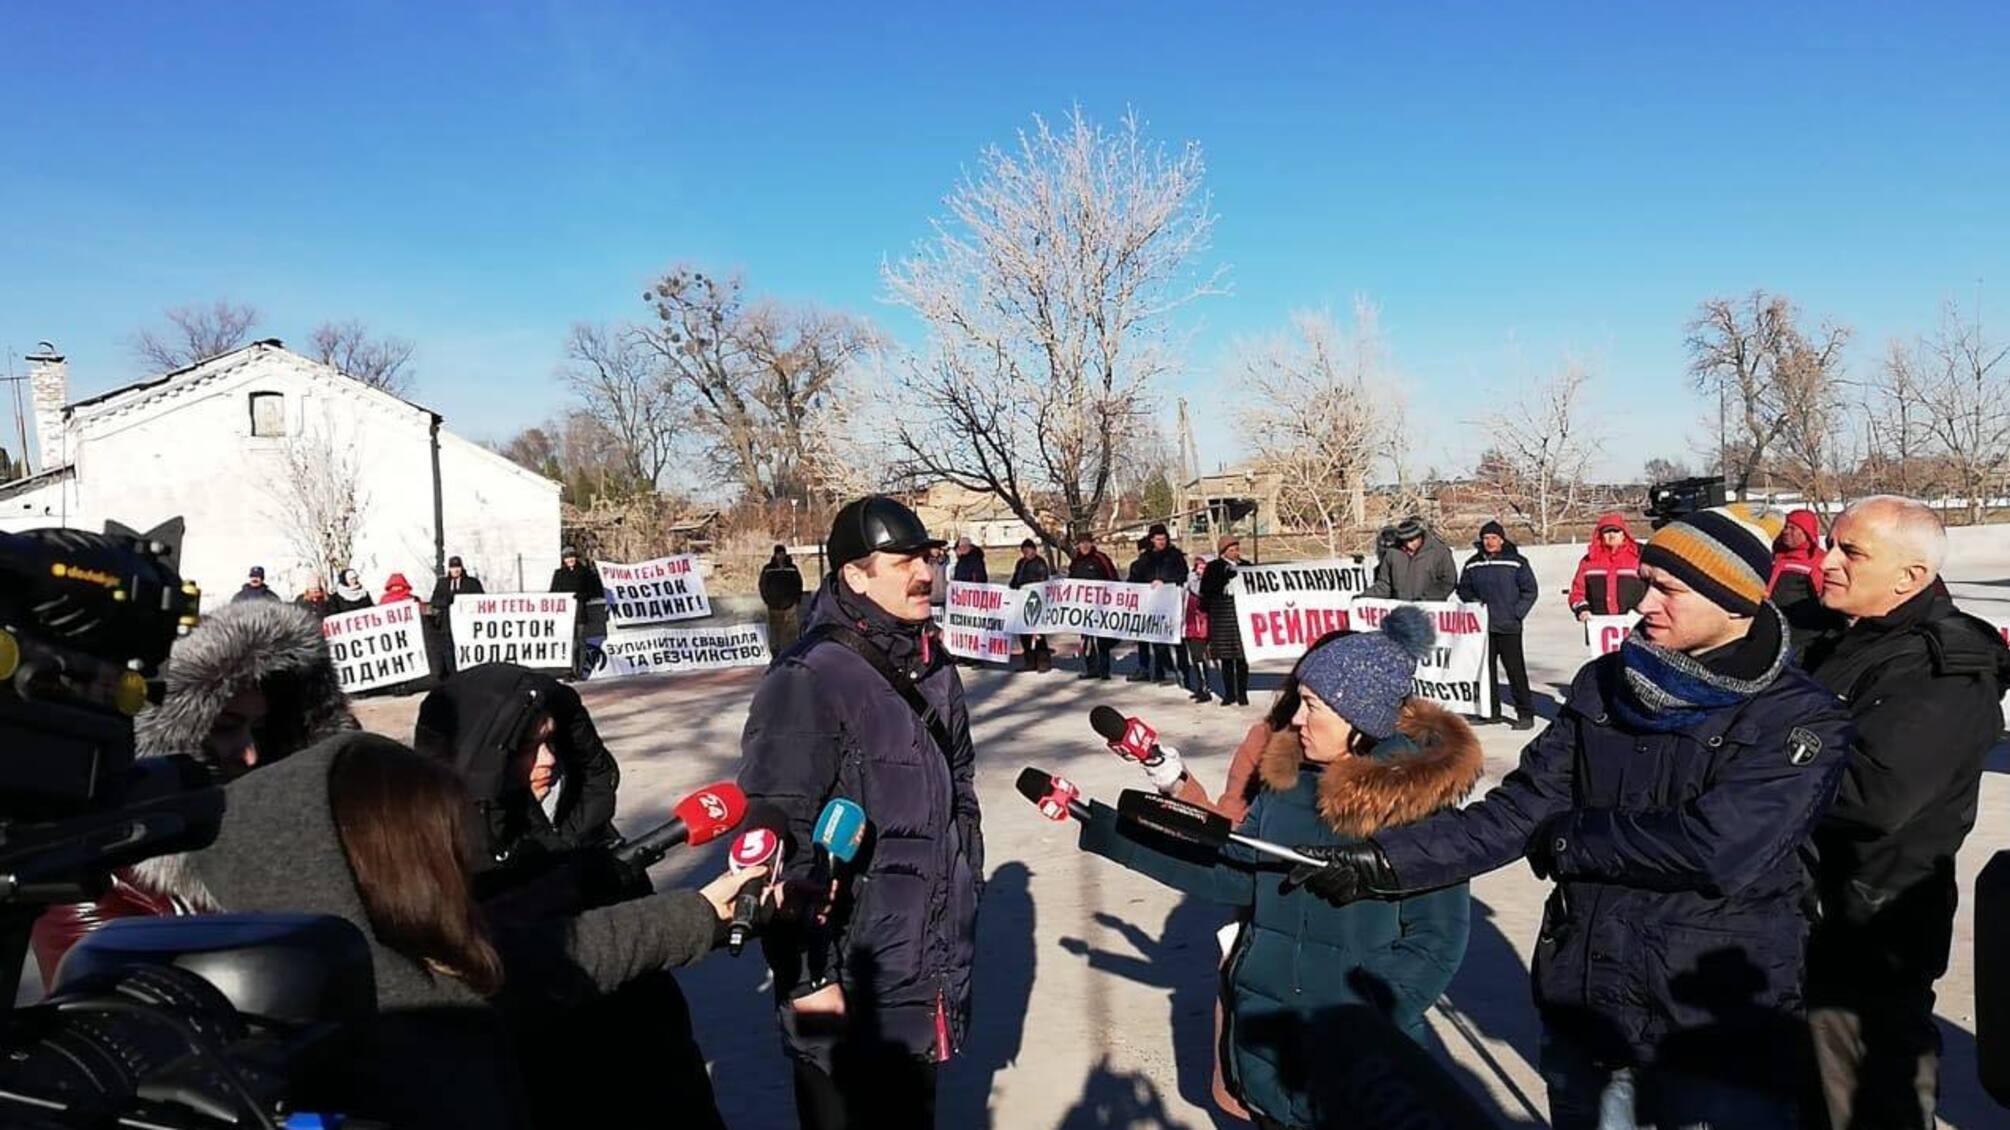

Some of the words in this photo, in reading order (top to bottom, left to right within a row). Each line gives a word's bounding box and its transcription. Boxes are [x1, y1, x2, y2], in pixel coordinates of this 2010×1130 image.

[634, 565, 664, 580] ГЕТЬ
[667, 559, 691, 575] ВІД
[616, 579, 688, 599] РОСТОК
[1242, 571, 1280, 595] НАС
[502, 598, 536, 613] ГЕТЬ
[541, 598, 567, 615] ВІД
[1076, 585, 1112, 605] ГЕТЬ
[610, 595, 703, 619] ХОЛДИНГ!
[345, 612, 382, 633] ГЕТЬ
[386, 606, 414, 624] ВІД
[473, 619, 554, 640] РОСТОК
[334, 630, 408, 661] ОСТОК
[460, 642, 567, 665] ХОЛДИНГ!
[606, 637, 687, 656] ЗУПИНИТИ
[692, 632, 758, 648] СВАВІЛЛЯ
[626, 655, 649, 668] ТА
[653, 645, 766, 665] БЕЗЧИНСТВО!
[740, 828, 766, 860] 5
